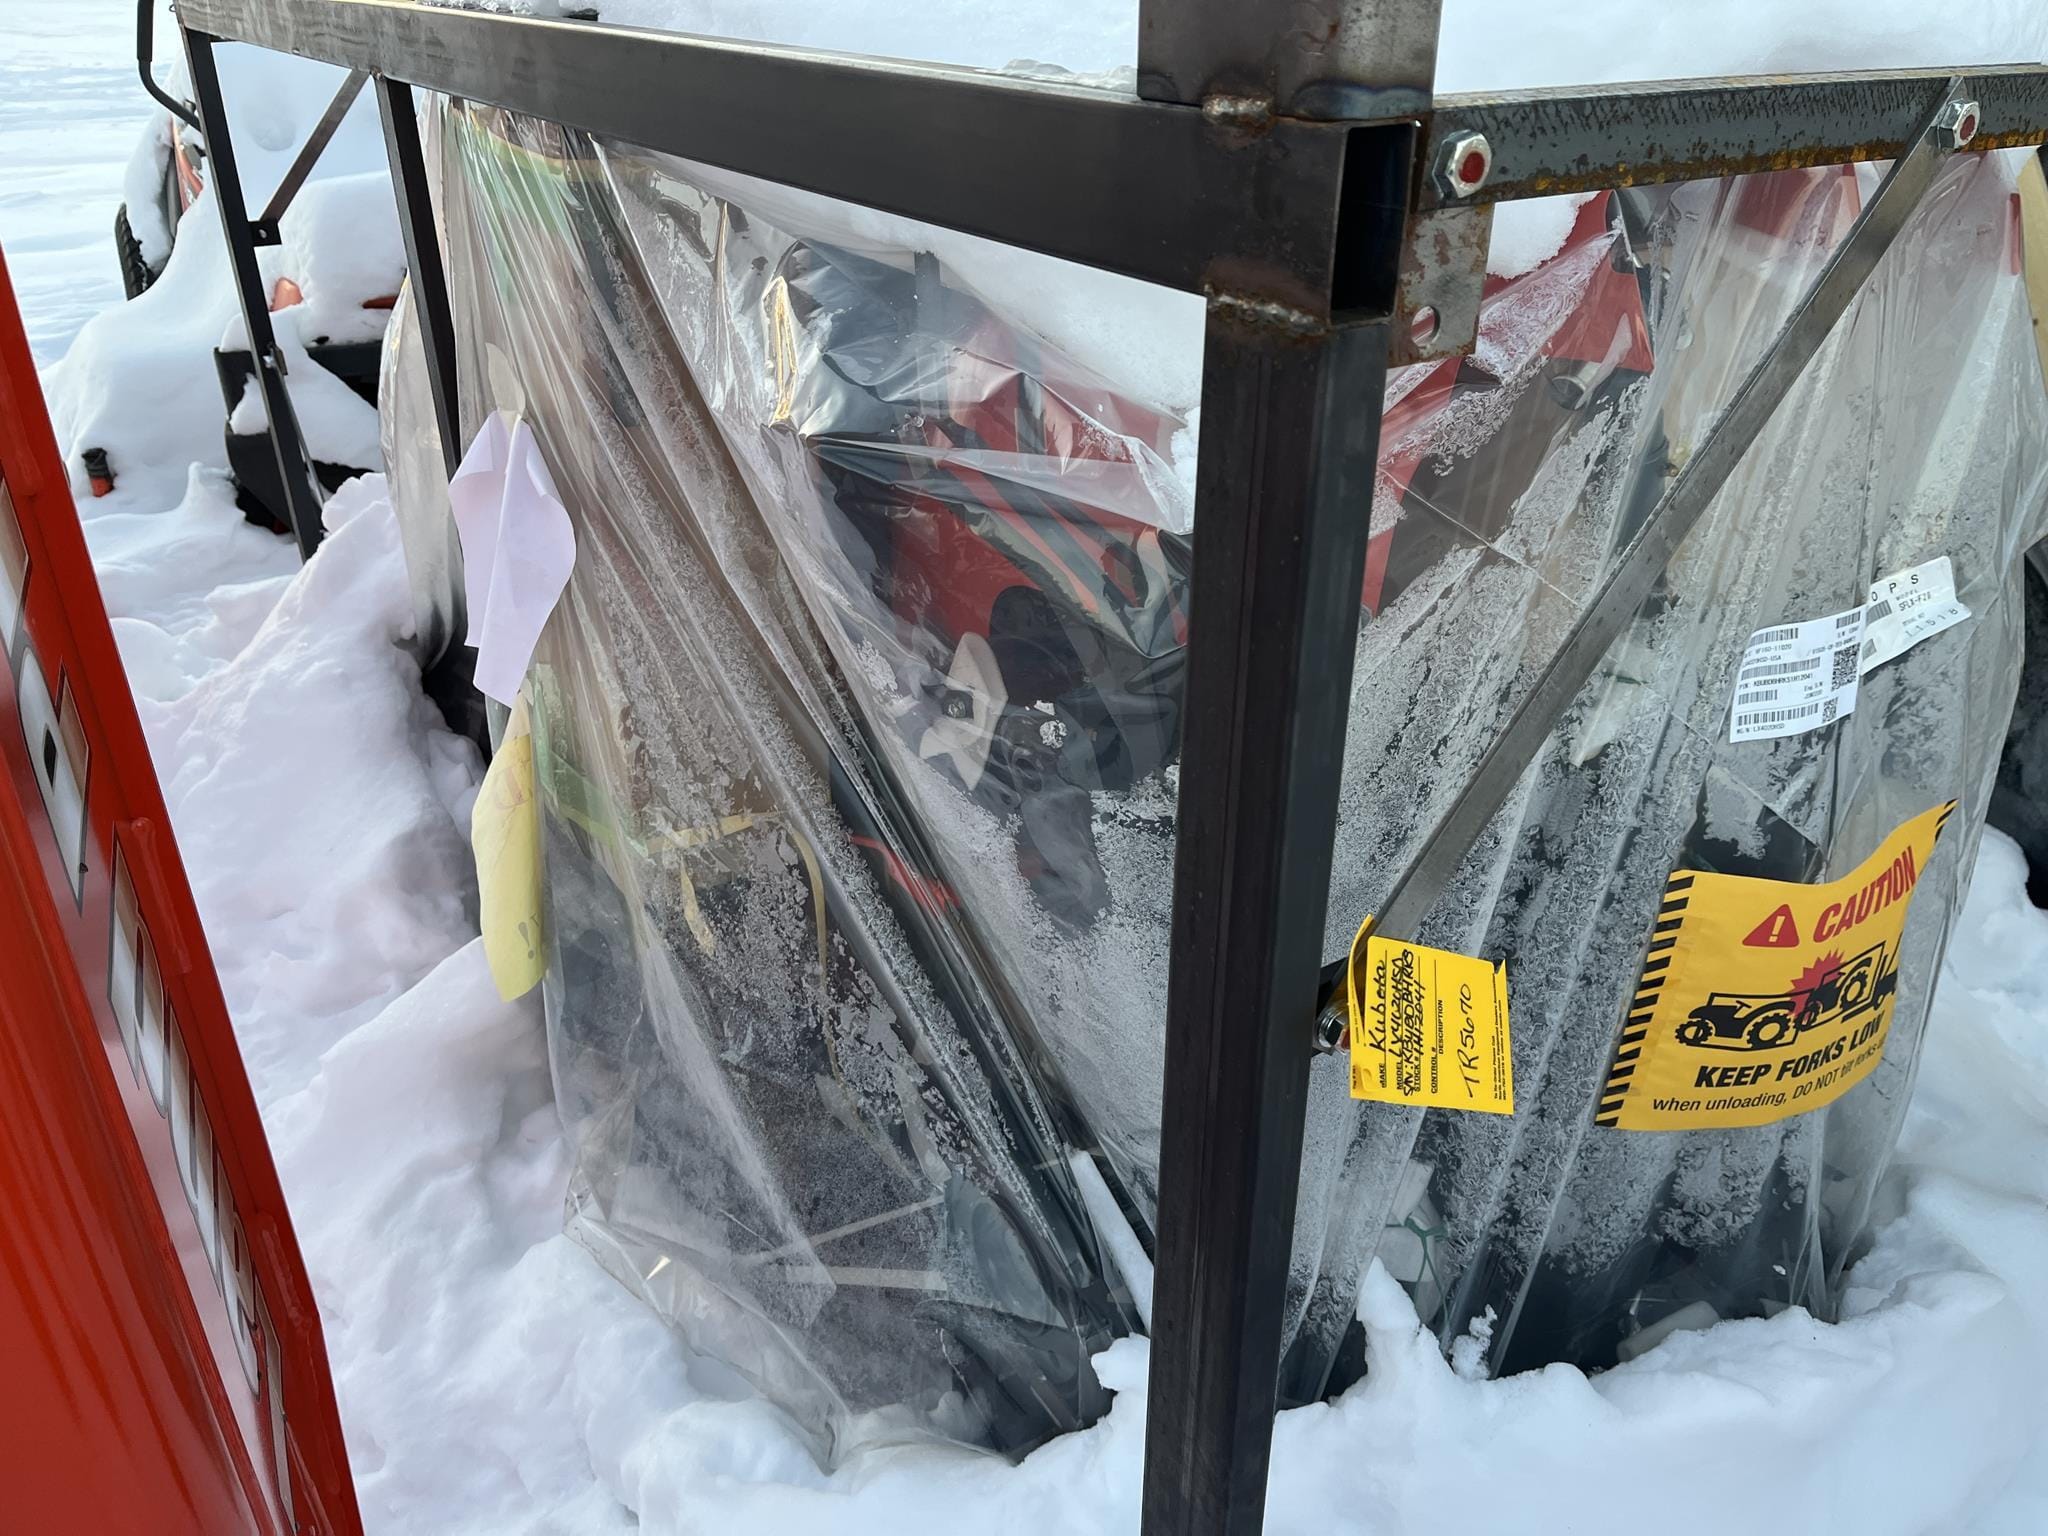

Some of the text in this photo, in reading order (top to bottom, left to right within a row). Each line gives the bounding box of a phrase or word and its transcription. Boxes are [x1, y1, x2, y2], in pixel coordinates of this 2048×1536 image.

[1813, 845, 1917, 944] CAUTION
[1694, 1062, 1773, 1088] KEEP
[1775, 1036, 1847, 1080] FORKS
[1848, 1010, 1885, 1052] LOW
[1652, 1096, 1701, 1112] When
[1705, 1089, 1788, 1112] unloading,
[1793, 1081, 1814, 1100] DO
[1814, 1067, 1840, 1091] NOT
